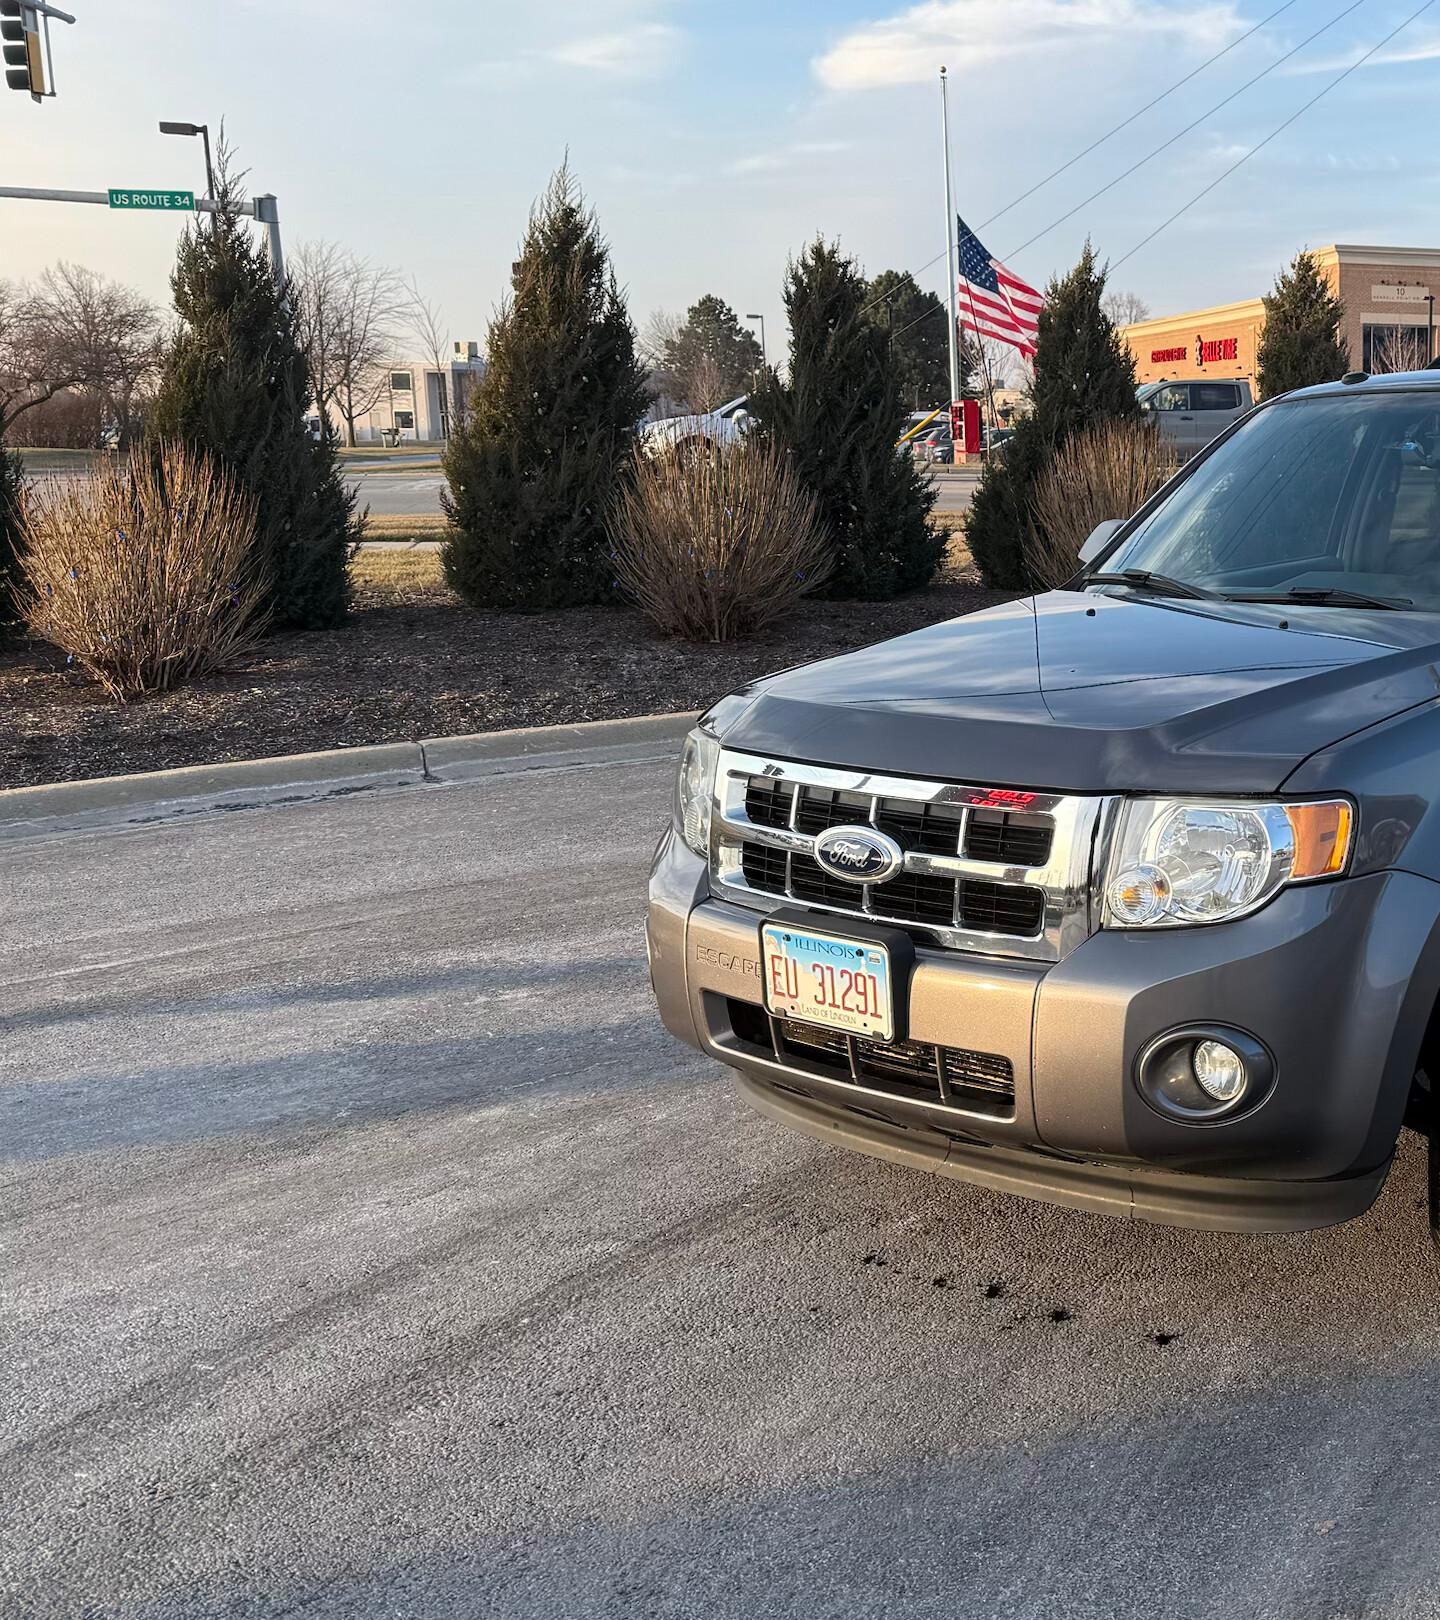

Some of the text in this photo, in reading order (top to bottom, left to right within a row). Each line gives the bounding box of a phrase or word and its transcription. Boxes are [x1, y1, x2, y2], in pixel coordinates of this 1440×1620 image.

[113, 194, 190, 207] US ROUTE 34
[1396, 287, 1405, 296] 10
[829, 840, 870, 868] Ford
[794, 937, 856, 960] ILLINOIS
[771, 954, 883, 1019] EU 31291
